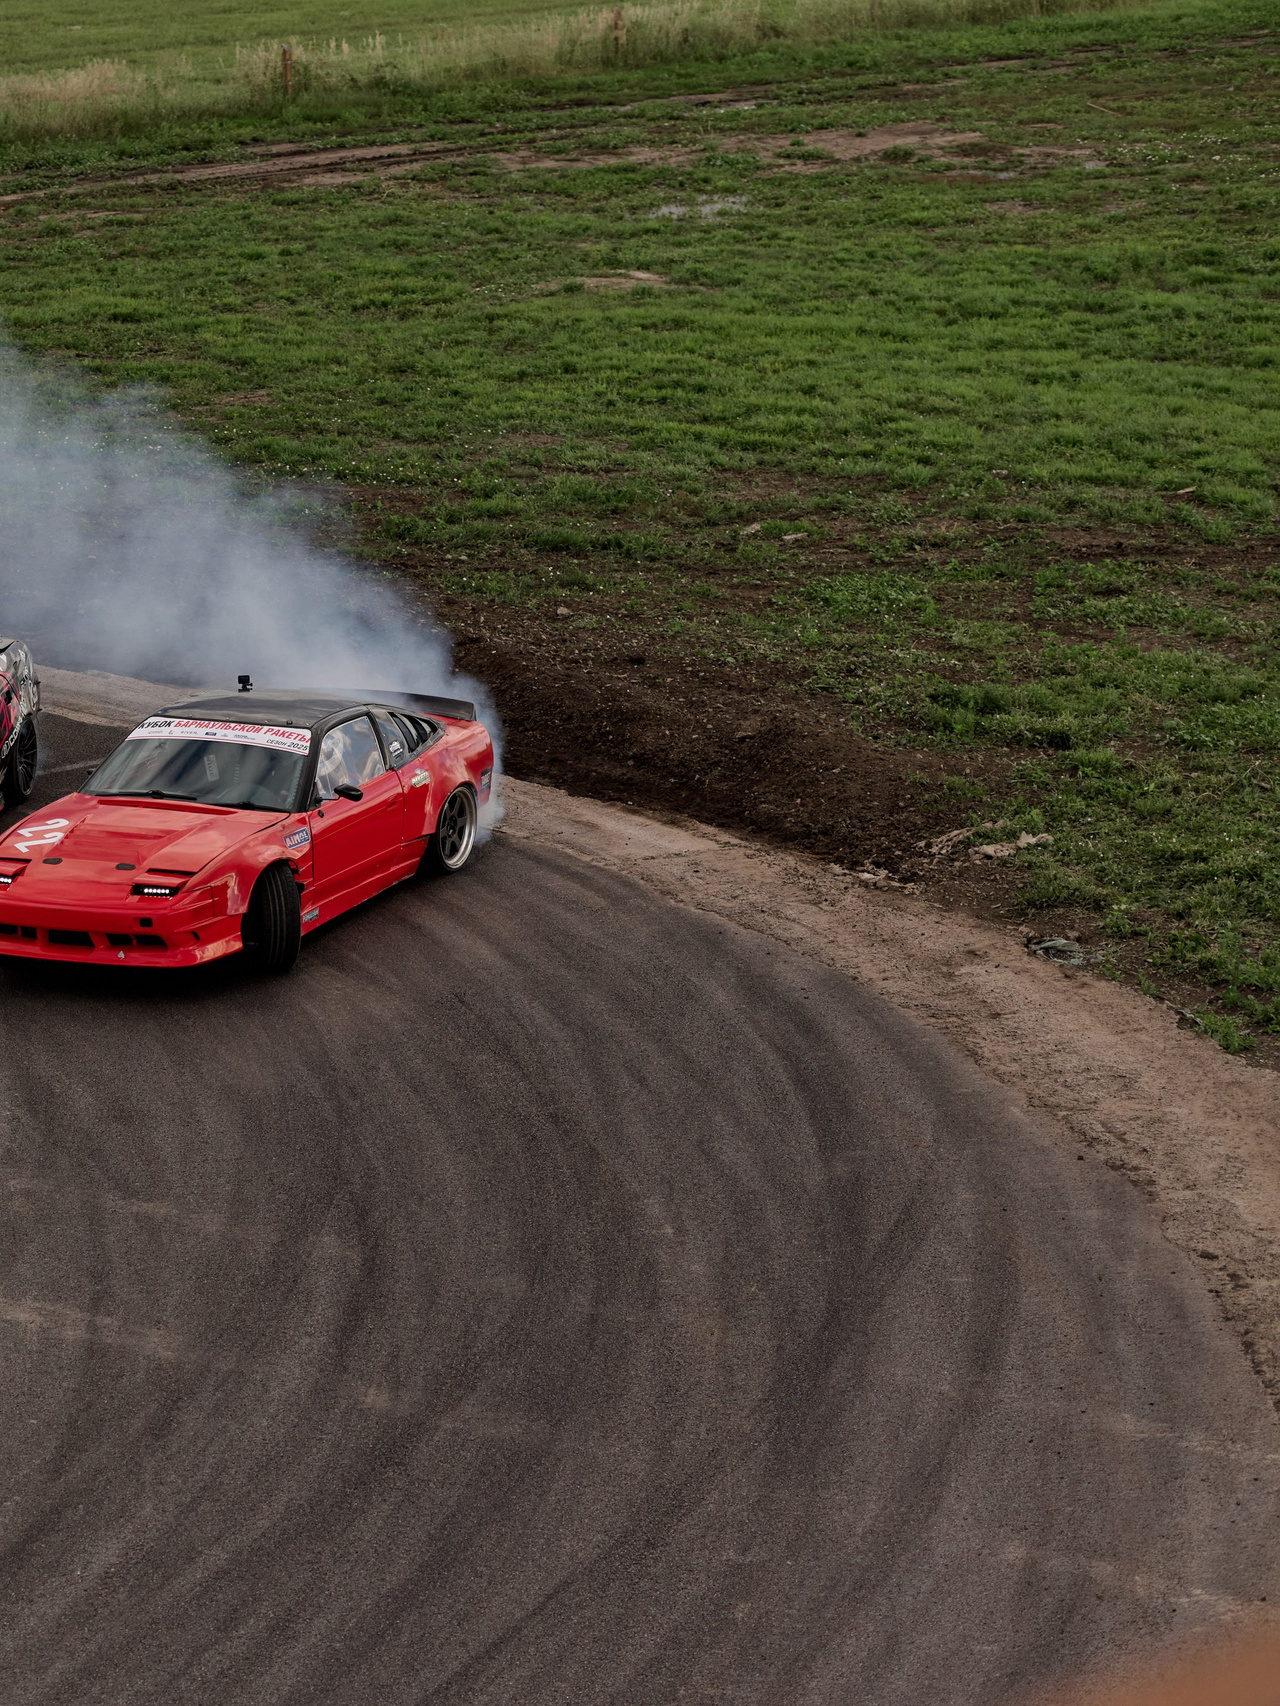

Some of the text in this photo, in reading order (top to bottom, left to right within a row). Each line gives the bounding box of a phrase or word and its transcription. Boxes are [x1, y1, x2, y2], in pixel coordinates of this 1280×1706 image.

[138, 720, 312, 743] КУБОК БАРНАУЛЬСКОЙ РАКЕТЫ
[266, 738, 309, 751] СЕЗОН 2025
[13, 818, 70, 854] 22
